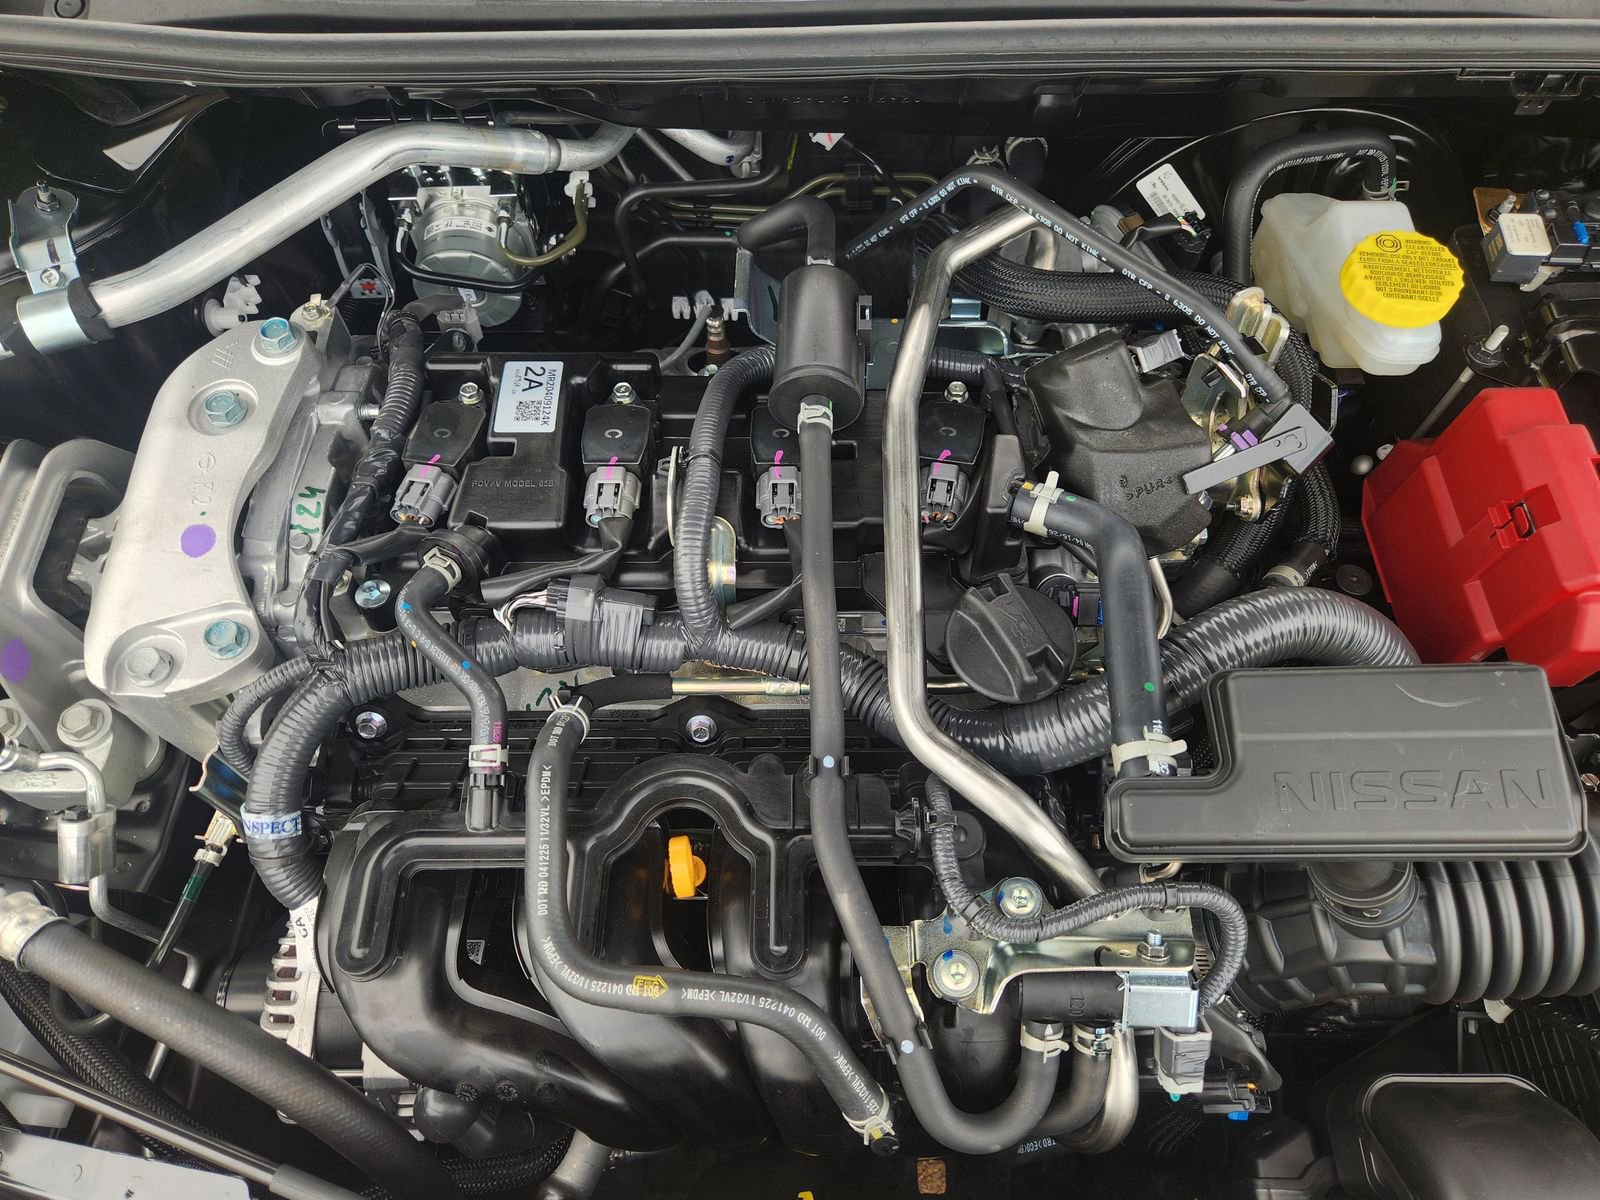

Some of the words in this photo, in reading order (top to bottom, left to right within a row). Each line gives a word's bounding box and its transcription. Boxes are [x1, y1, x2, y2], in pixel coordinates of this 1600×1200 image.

[946, 181, 957, 192] NOT
[955, 177, 972, 186] KINK
[991, 184, 1004, 197] DTR
[1035, 213, 1052, 228] 6305
[1053, 224, 1063, 235] DO
[1065, 232, 1080, 245] NOT
[1081, 242, 1099, 257] KINK
[1121, 268, 1136, 281] DTR
[1138, 278, 1153, 290] CFP
[1173, 299, 1194, 316] 6305
[1194, 314, 1206, 326] DO
[1205, 325, 1220, 339] NOT
[521, 366, 546, 392] 2A
[1244, 373, 1257, 387] DTR
[1254, 385, 1267, 398] CFP
[540, 369, 557, 426] MR20409124K
[504, 480, 536, 488] MODEL
[540, 765, 552, 803] >EPDM<
[1273, 769, 1557, 812] NISSAN
[539, 805, 551, 842] 11/32VL
[538, 844, 550, 878] 041225
[538, 900, 549, 916] DOT
[540, 935, 563, 971] >EPDM<
[560, 961, 591, 990] 11/32VL
[591, 979, 624, 996] 041225
[681, 988, 717, 1001] >EPDM<
[719, 990, 757, 1007] 11/32VL
[758, 995, 796, 1018] 041225
[811, 1023, 827, 1041] DOT
[834, 1051, 855, 1080] >EPDM<
[851, 1075, 871, 1104] 11/32VL
